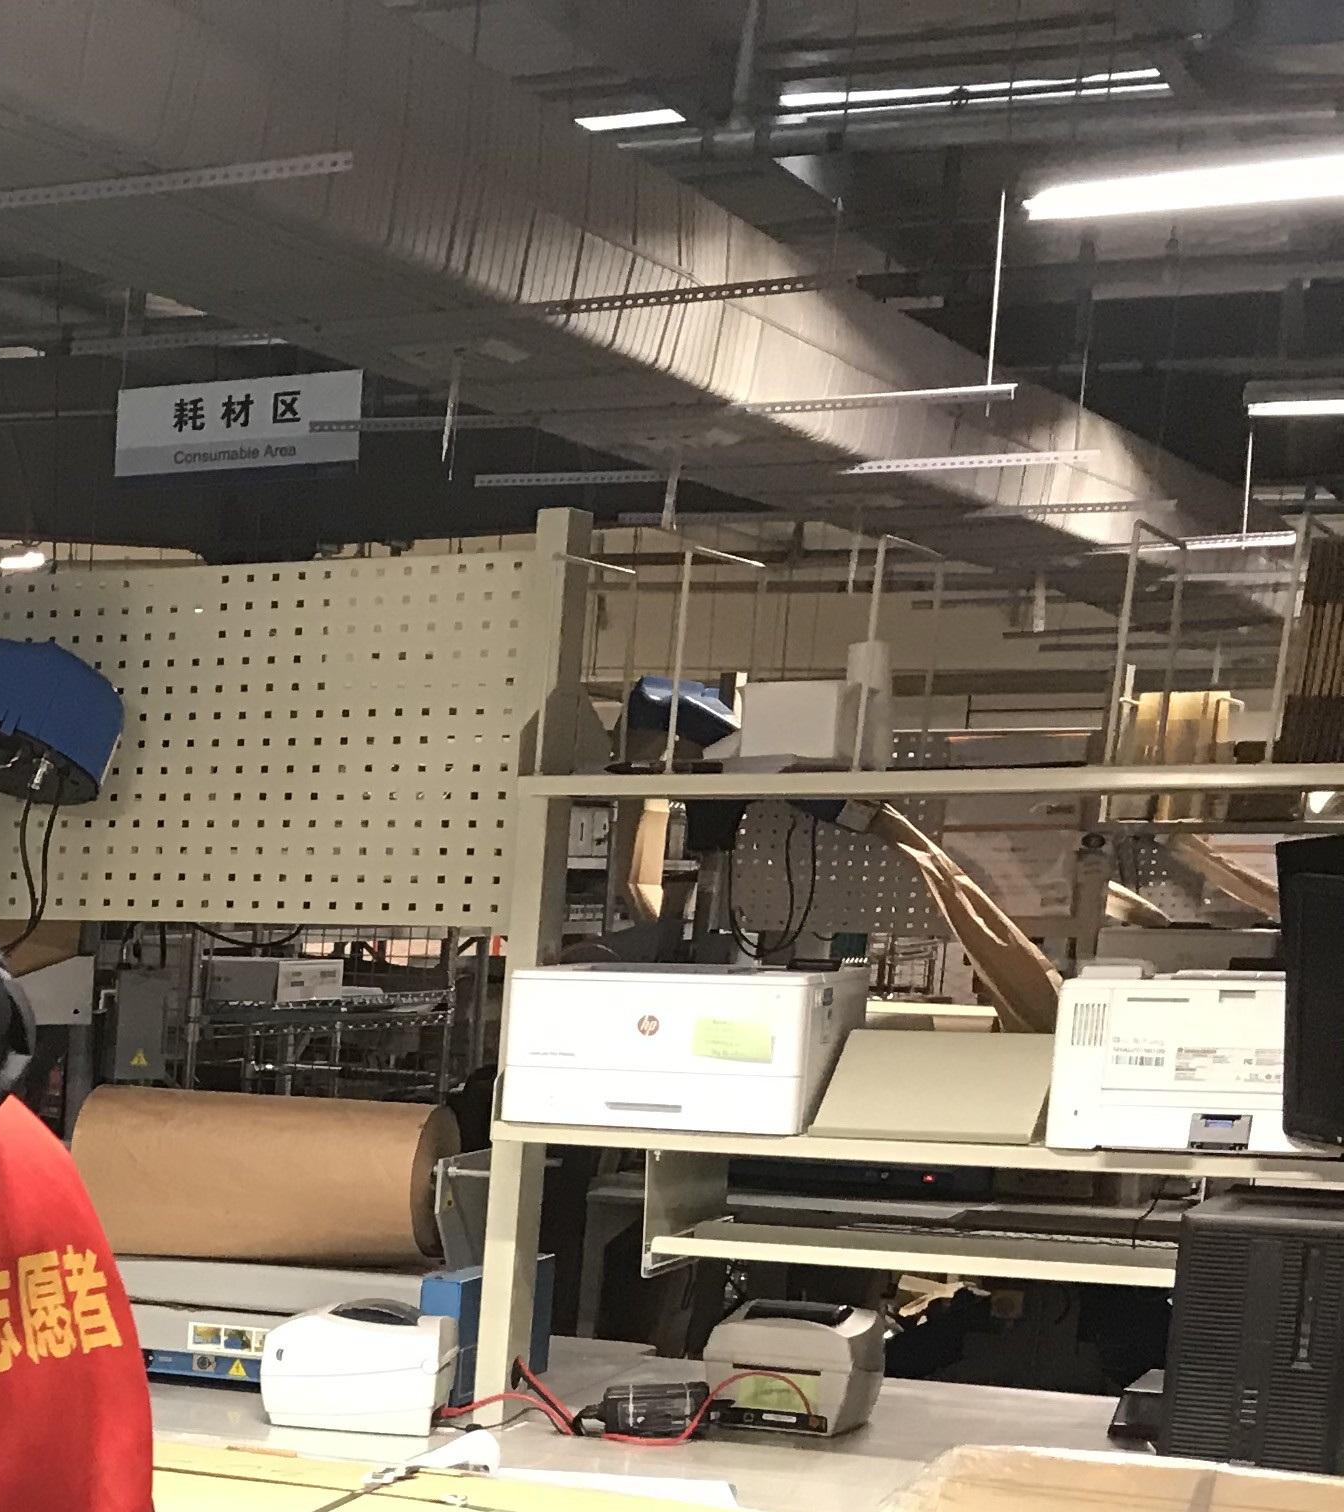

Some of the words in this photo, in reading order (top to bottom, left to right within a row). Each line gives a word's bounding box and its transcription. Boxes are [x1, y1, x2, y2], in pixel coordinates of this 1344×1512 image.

[172, 390, 301, 432] 耗材区
[173, 446, 260, 465] Consumable
[264, 444, 297, 458] Area
[640, 1014, 658, 1036] hp
